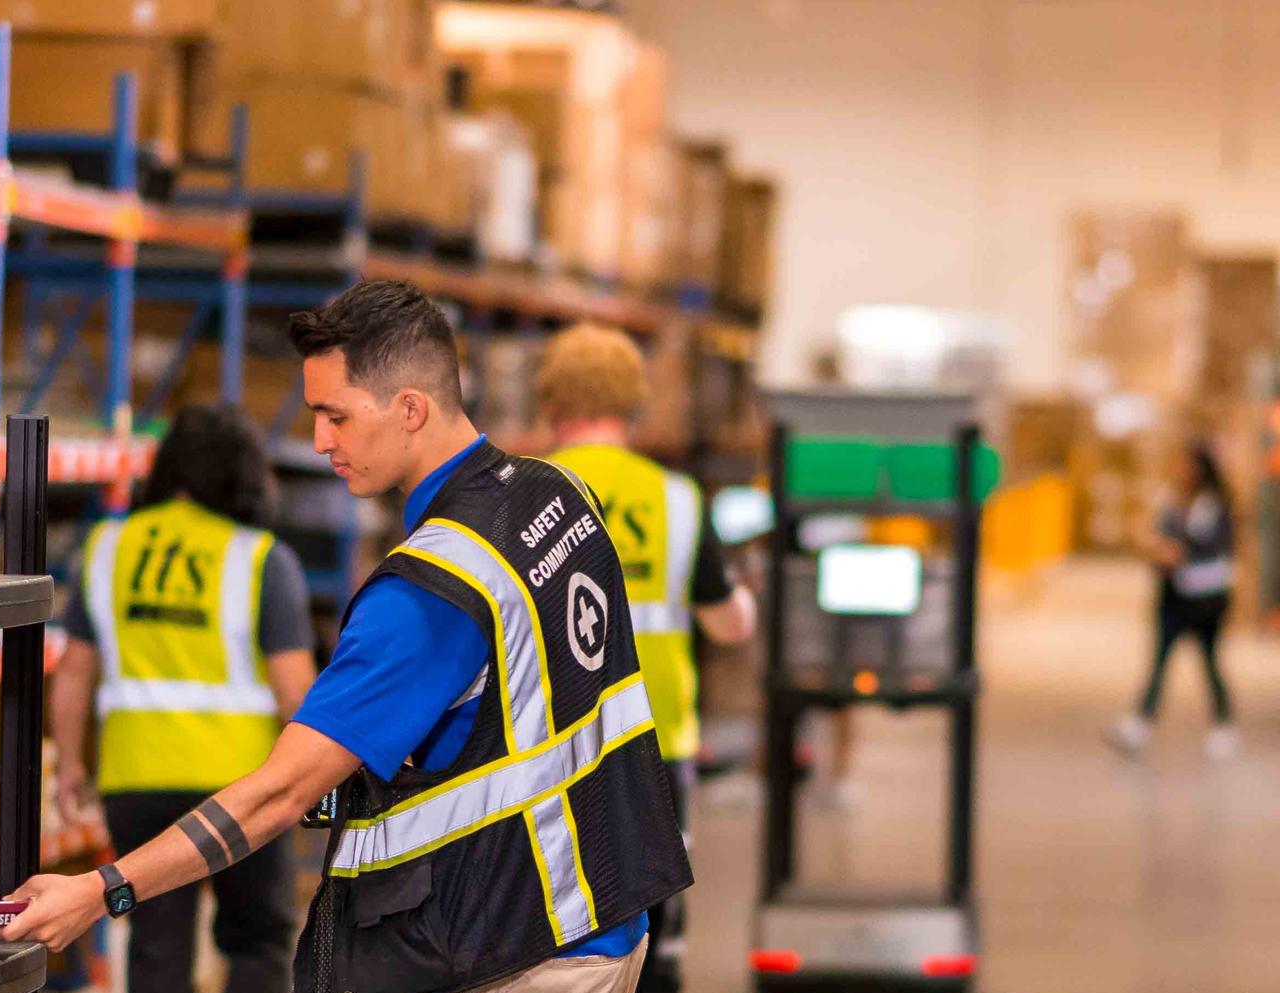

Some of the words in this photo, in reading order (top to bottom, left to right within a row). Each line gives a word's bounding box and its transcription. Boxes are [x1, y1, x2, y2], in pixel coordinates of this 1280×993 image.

[520, 496, 566, 549] SAFETY
[528, 513, 598, 588] COMMITTEE
[130, 526, 214, 597] its
